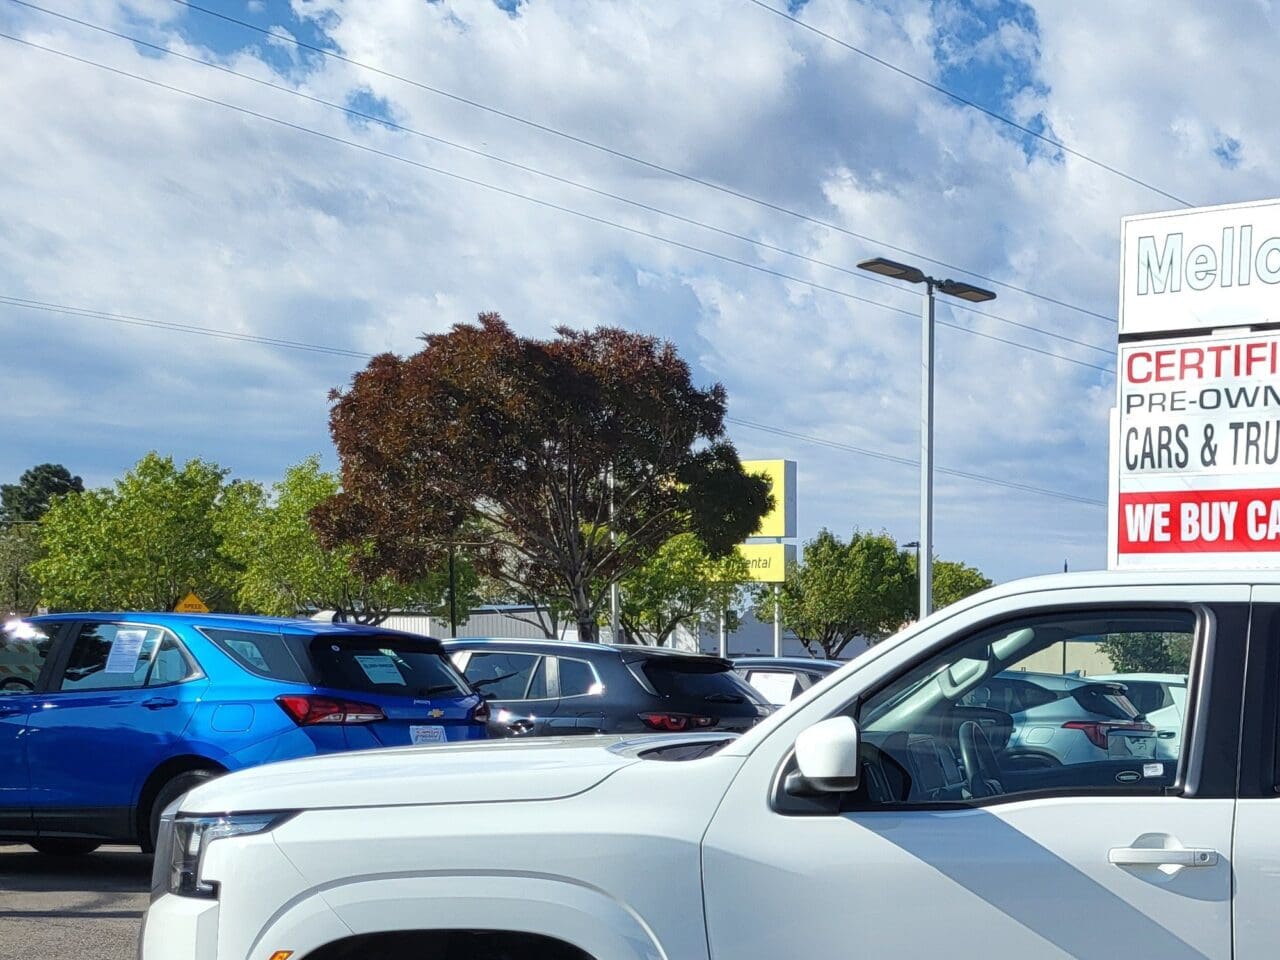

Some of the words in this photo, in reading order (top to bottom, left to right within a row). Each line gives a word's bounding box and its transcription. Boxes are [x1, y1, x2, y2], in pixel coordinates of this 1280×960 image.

[1125, 423, 1189, 471] CARS
[1200, 423, 1218, 467] &
[1125, 503, 1171, 542] WE
[1180, 501, 1238, 542] BUY
[741, 557, 772, 568] ental
